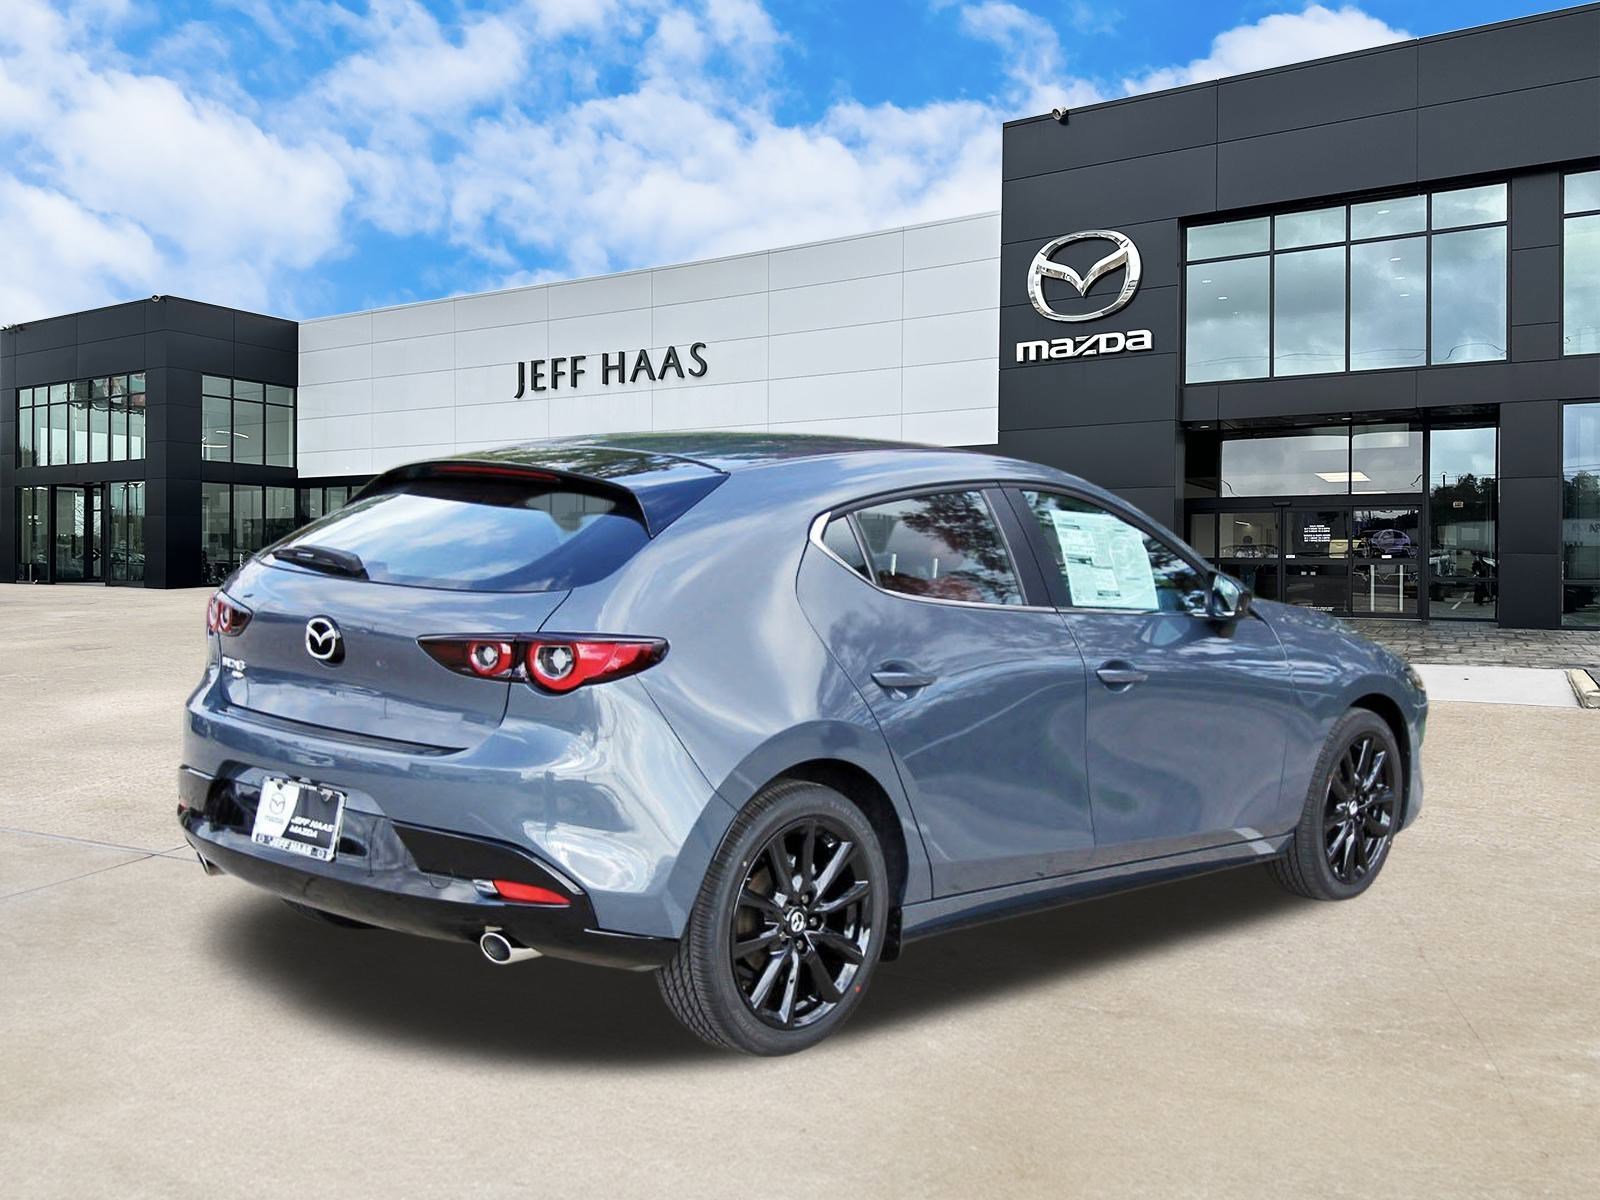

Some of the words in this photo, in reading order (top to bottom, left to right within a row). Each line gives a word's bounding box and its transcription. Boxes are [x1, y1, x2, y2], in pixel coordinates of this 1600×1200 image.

[514, 355, 586, 399] JEFF
[602, 342, 708, 386] HAAS
[289, 826, 318, 838] MAZDA
[291, 816, 310, 826] JEFF
[310, 820, 334, 832] HAAS
